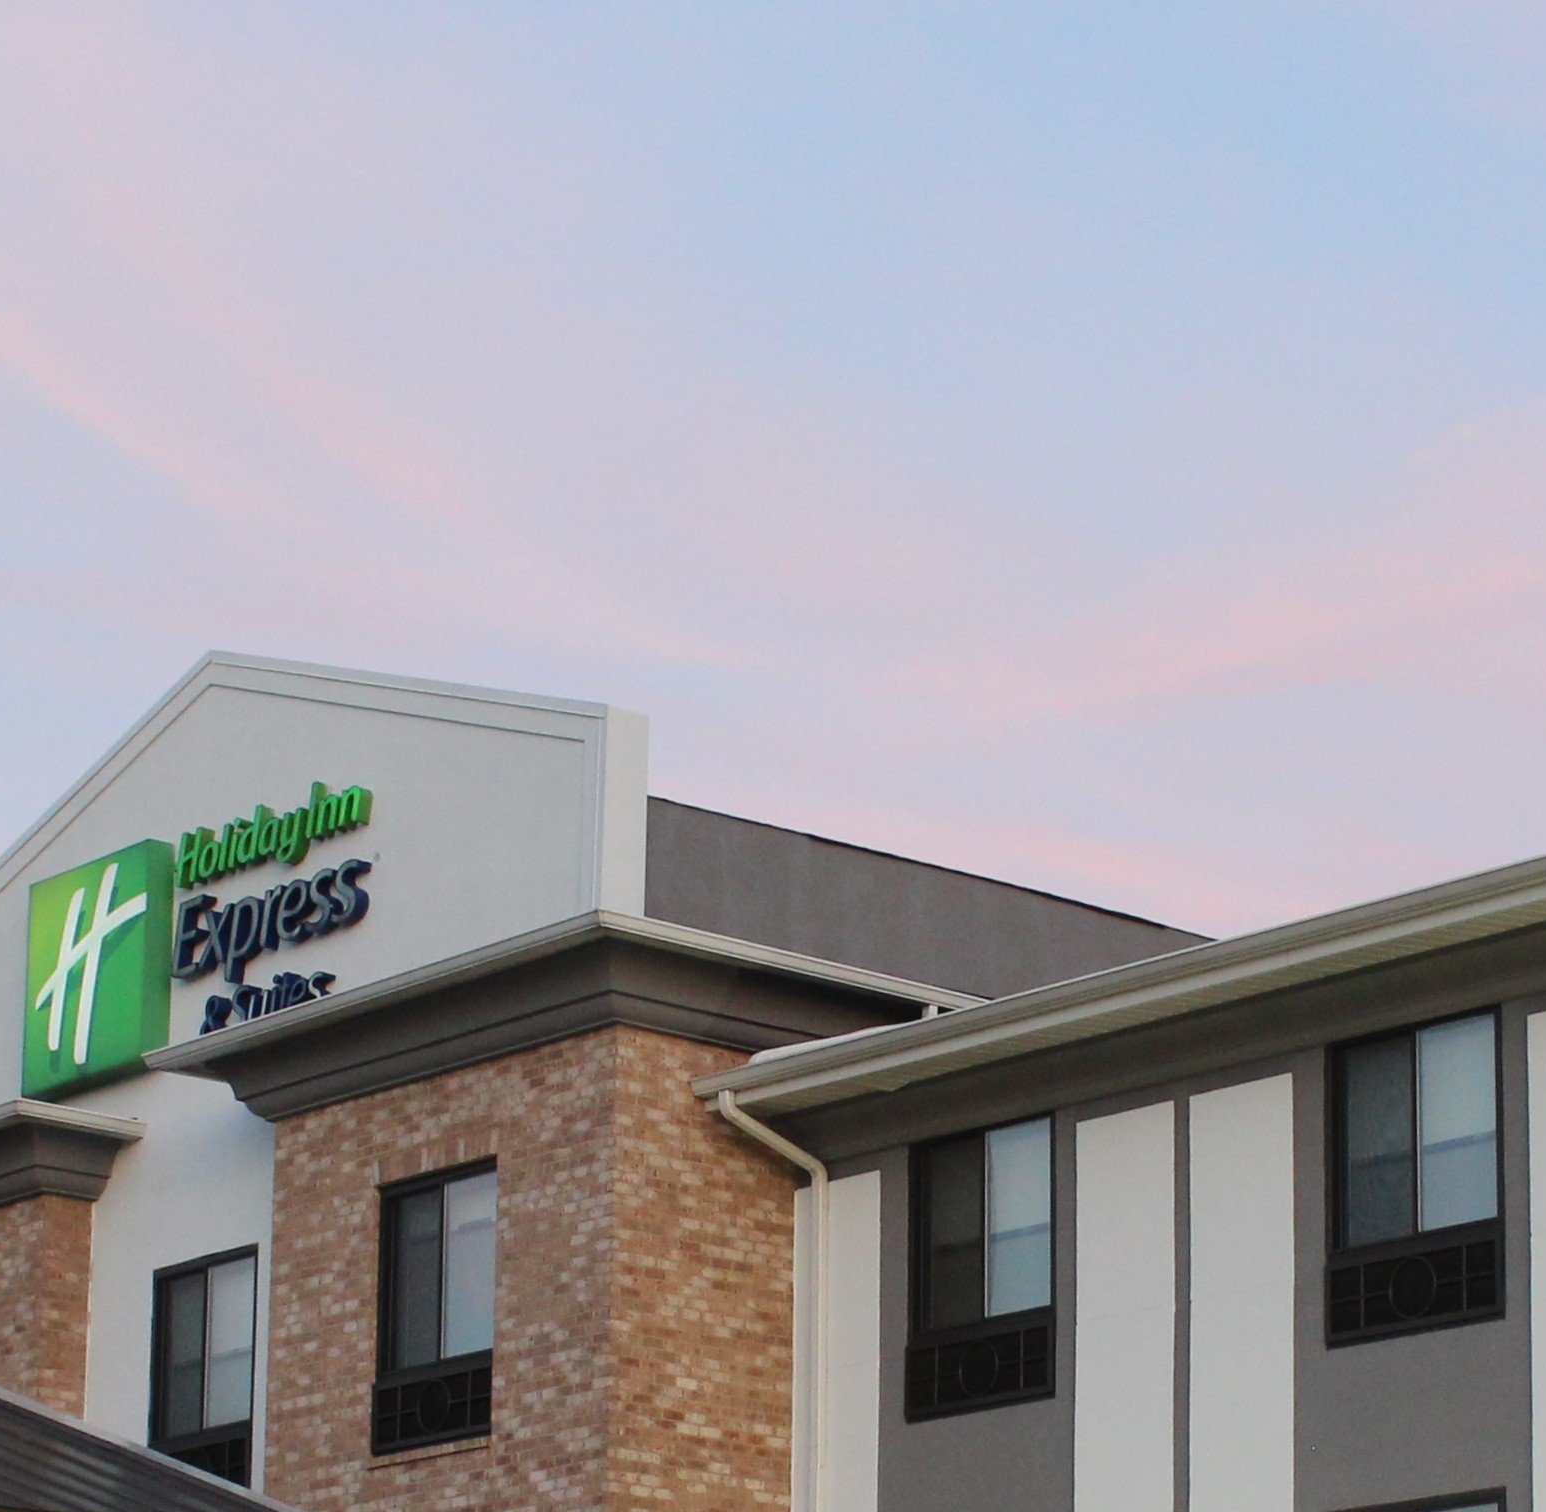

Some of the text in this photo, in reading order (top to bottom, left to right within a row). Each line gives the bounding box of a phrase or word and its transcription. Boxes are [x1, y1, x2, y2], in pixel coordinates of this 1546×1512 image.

[174, 781, 373, 889] Holiday Inn
[171, 859, 371, 984] Express
